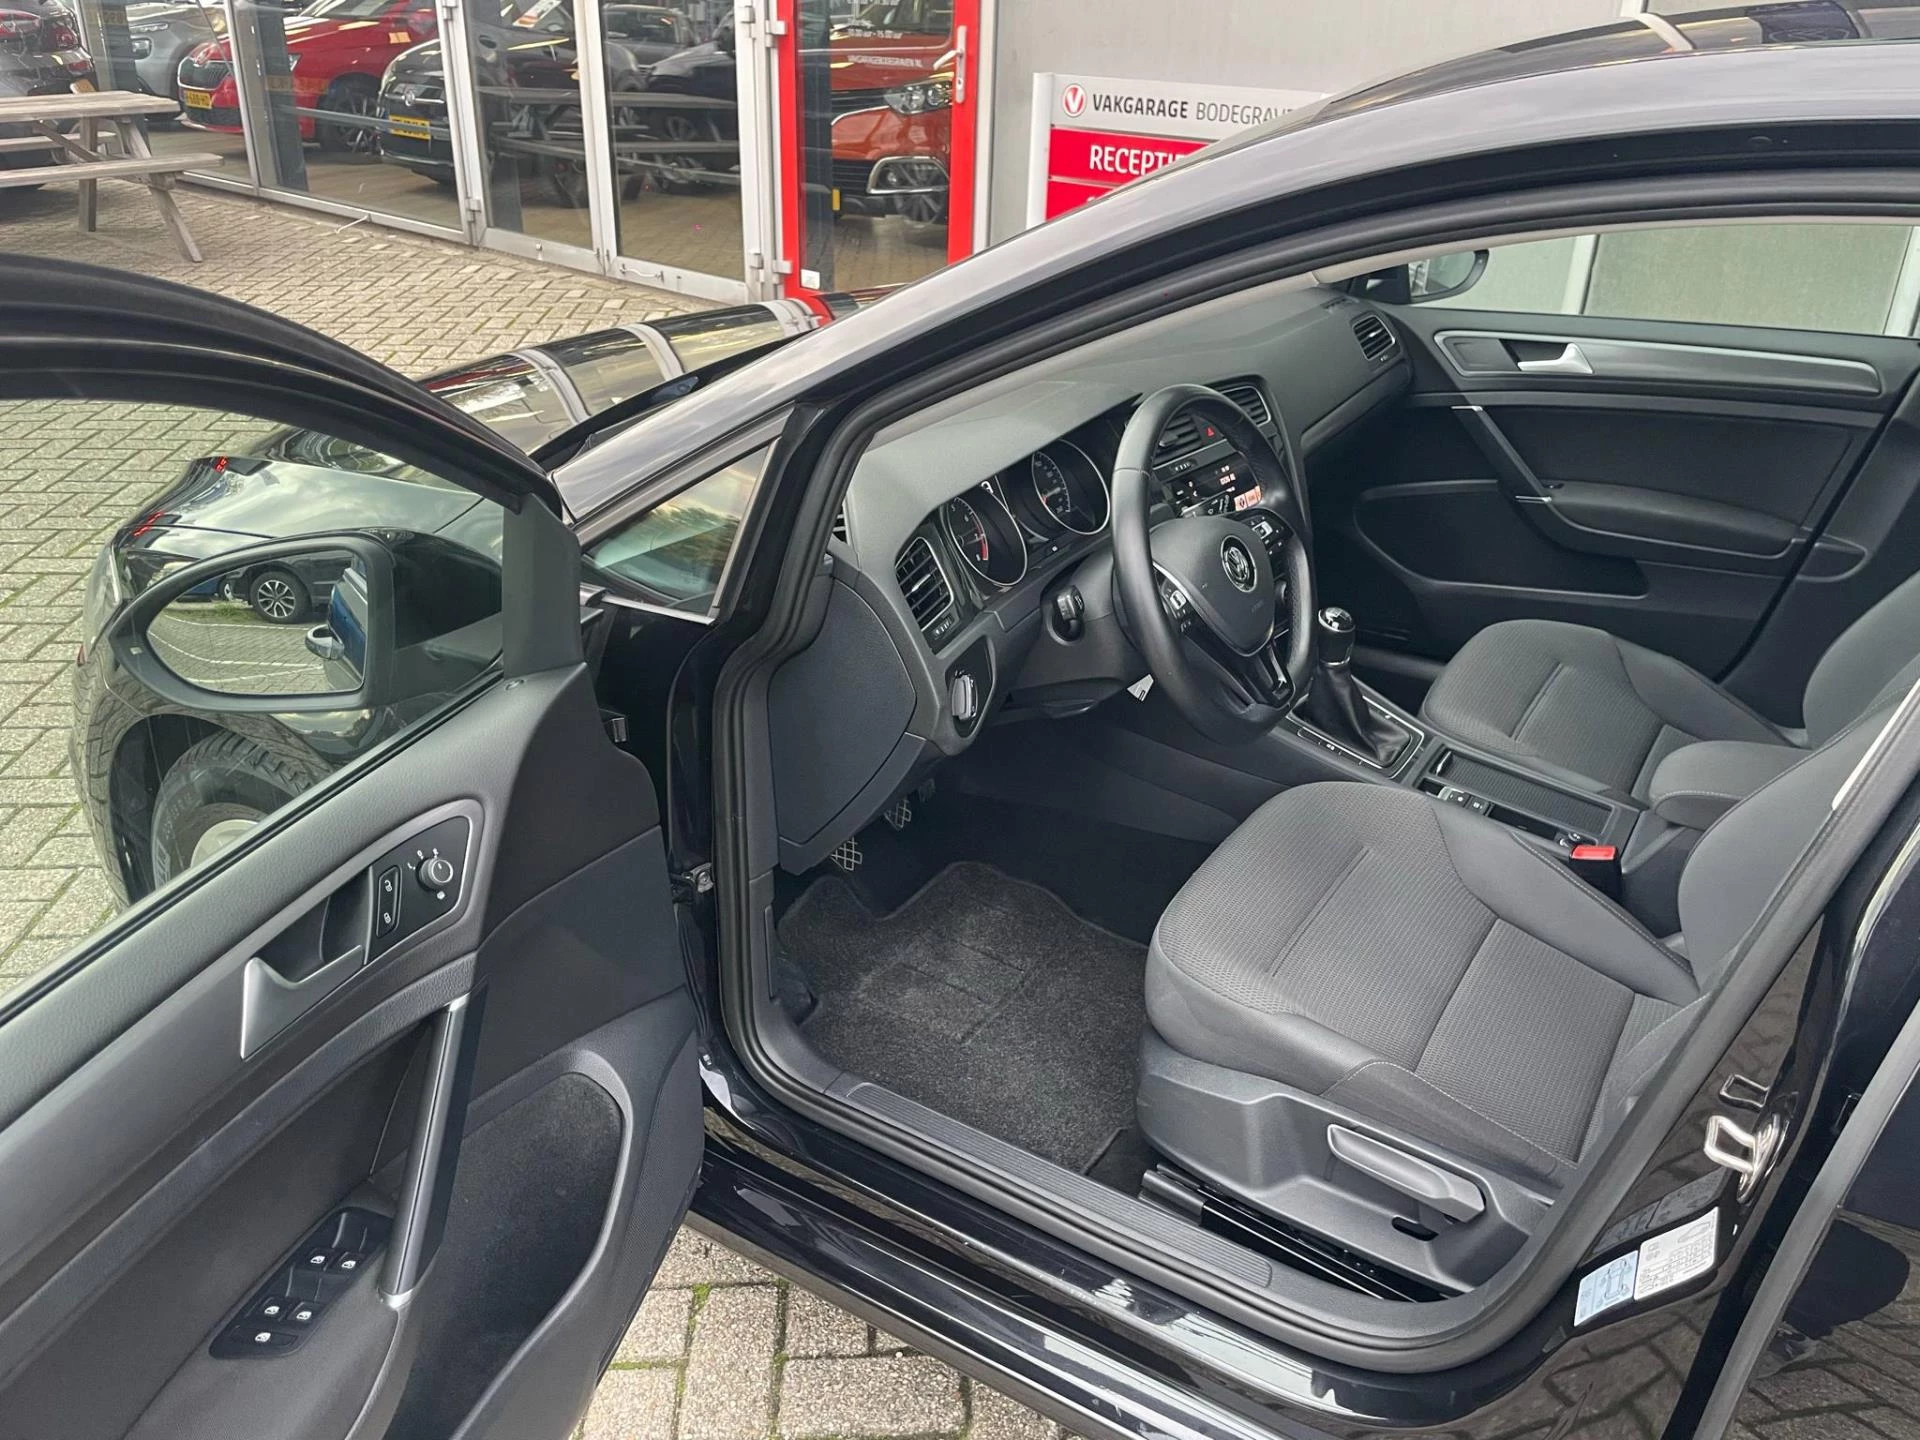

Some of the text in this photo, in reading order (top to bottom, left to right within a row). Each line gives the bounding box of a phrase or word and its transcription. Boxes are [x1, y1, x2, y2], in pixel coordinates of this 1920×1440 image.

[1092, 93, 1294, 125] VAKGARAGE BODEGRA
[1089, 144, 1186, 176] RECEPT
